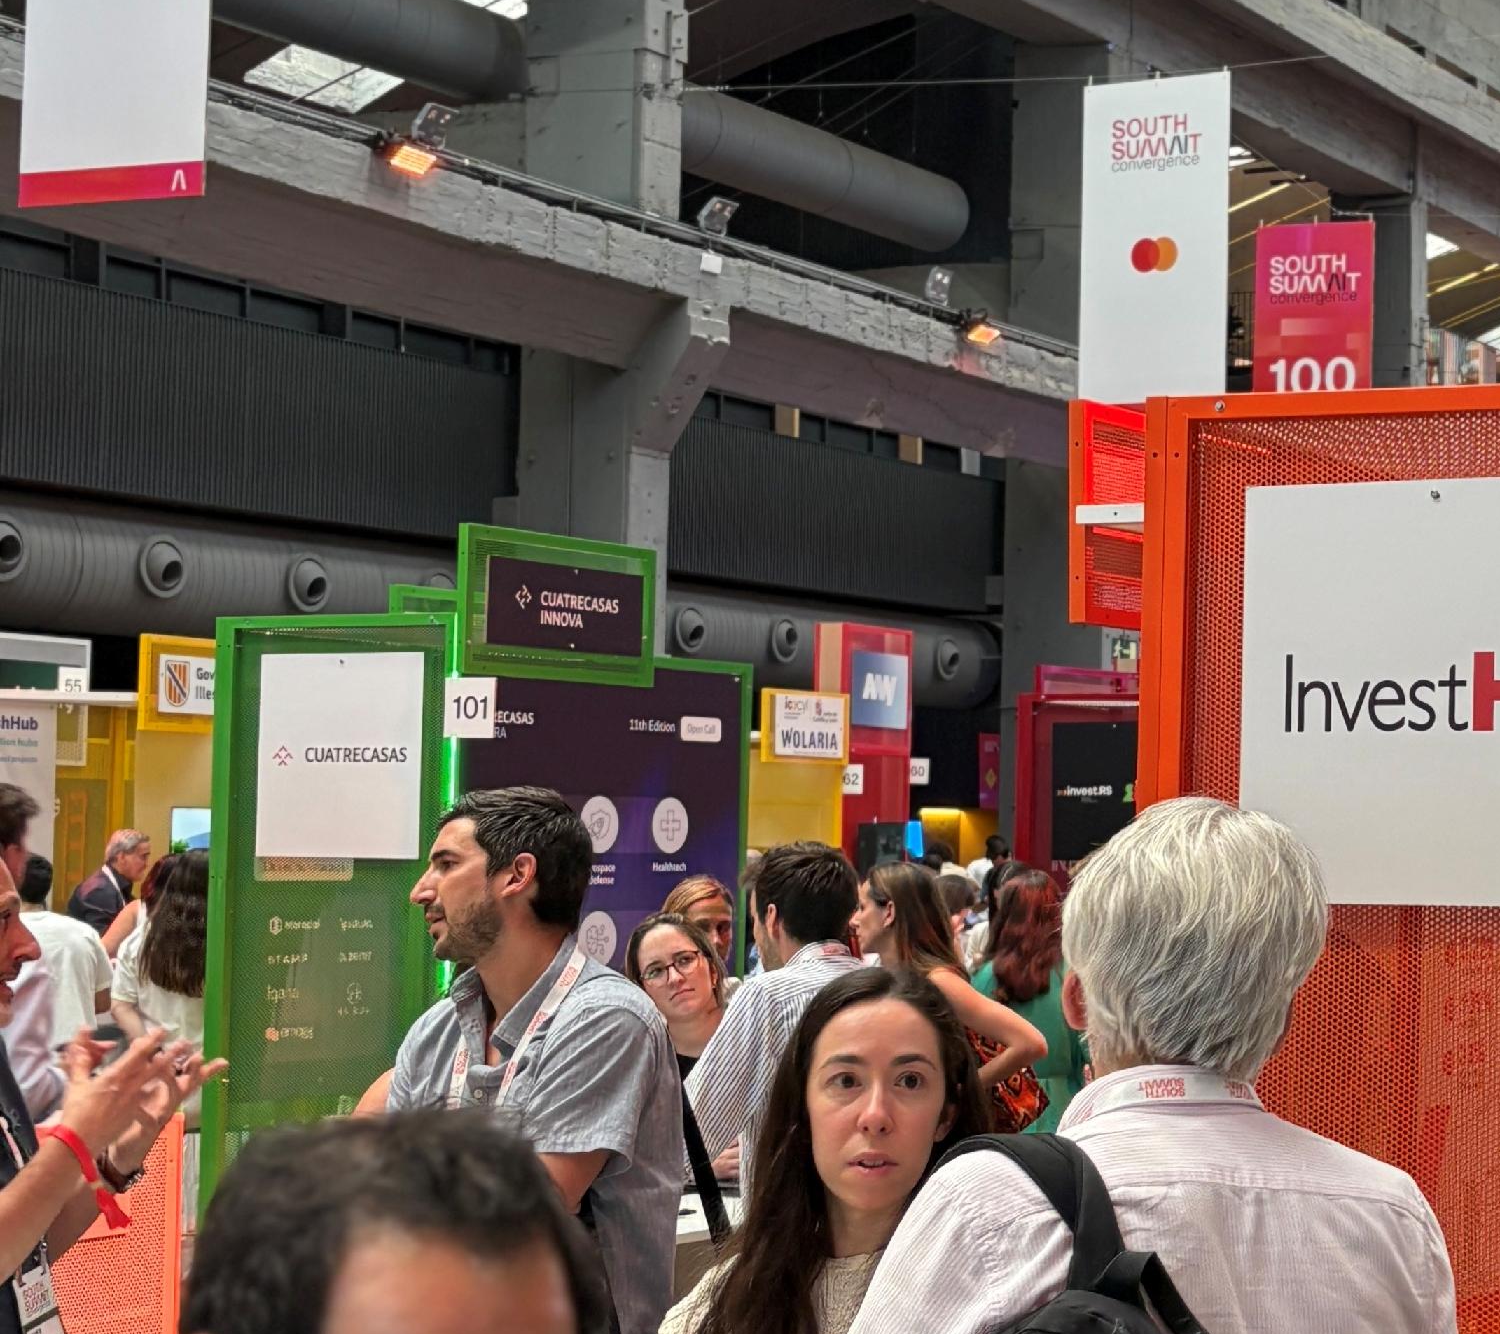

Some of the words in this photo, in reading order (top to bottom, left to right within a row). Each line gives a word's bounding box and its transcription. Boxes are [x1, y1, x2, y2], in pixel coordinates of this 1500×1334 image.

[1112, 114, 1188, 139] SOUTH
[1111, 133, 1202, 161] SUMMIT
[1111, 154, 1200, 172] convergence
[1269, 254, 1346, 275] SOUTH
[1269, 272, 1361, 294] SUMMIT
[1269, 292, 1357, 306] convergence
[1269, 356, 1356, 393] 100
[540, 590, 619, 614] CUATRECASAS
[540, 610, 583, 629] INNOVA
[65, 679, 82, 692] 55
[452, 695, 489, 720] 101
[494, 711, 535, 725] ECASAS
[629, 718, 647, 731] 11th
[648, 719, 676, 733] Edition
[781, 728, 838, 750] WOLARIA
[304, 747, 408, 763] CUATRECASAS
[1145, 1086, 1186, 1099] SOUTH
